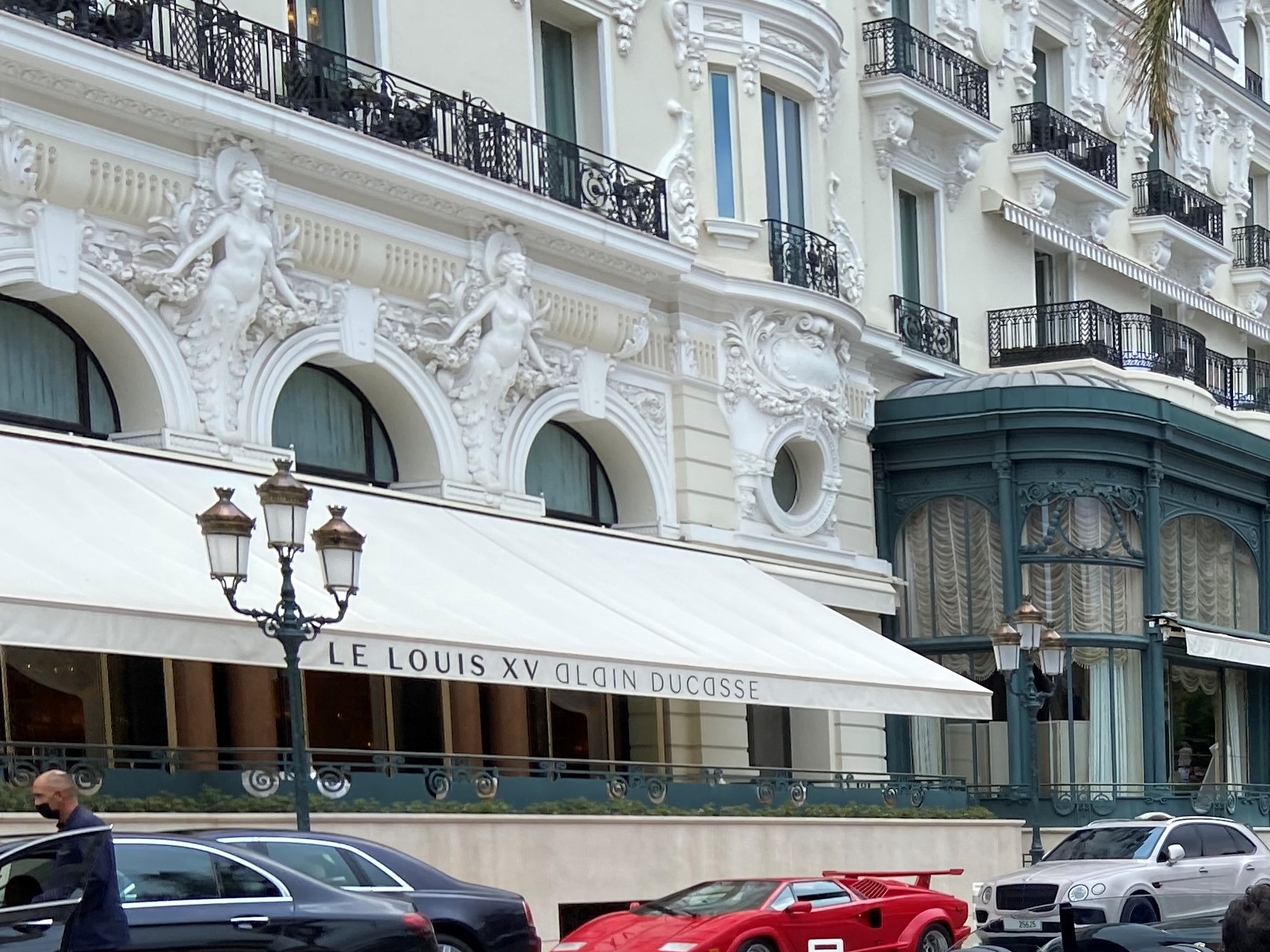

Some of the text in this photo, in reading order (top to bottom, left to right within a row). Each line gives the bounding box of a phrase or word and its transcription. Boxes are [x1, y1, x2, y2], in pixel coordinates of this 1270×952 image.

[329, 641, 368, 668] LE
[388, 646, 485, 677] LOUIS
[502, 657, 538, 680] XV
